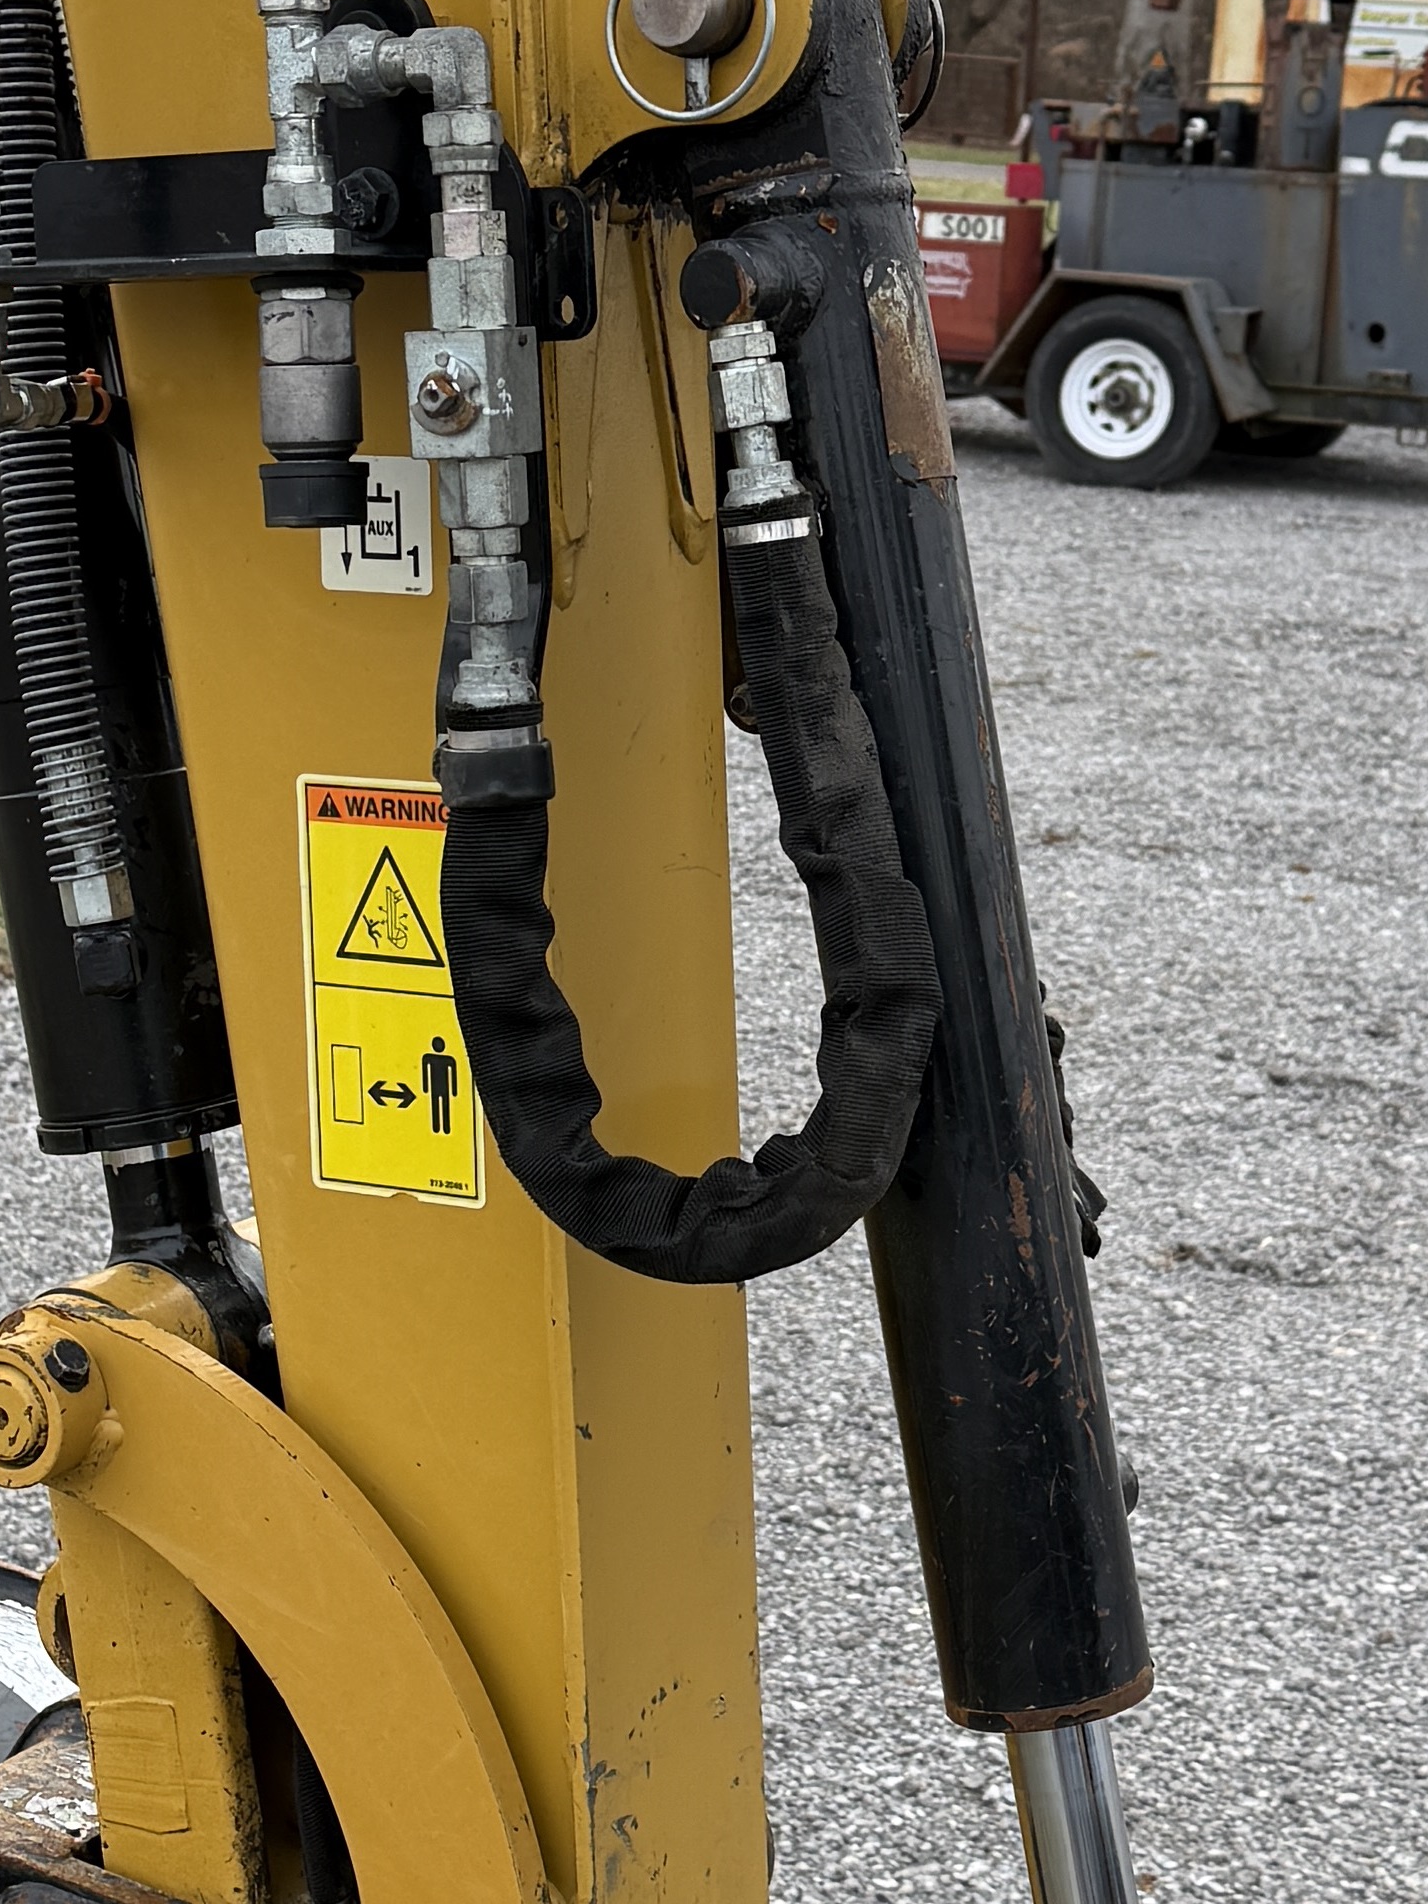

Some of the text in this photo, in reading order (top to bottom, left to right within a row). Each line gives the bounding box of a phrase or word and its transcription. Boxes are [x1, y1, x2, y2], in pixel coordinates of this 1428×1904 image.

[367, 520, 394, 537] AUX
[406, 545, 420, 578] 1
[344, 794, 450, 825] WARNING
